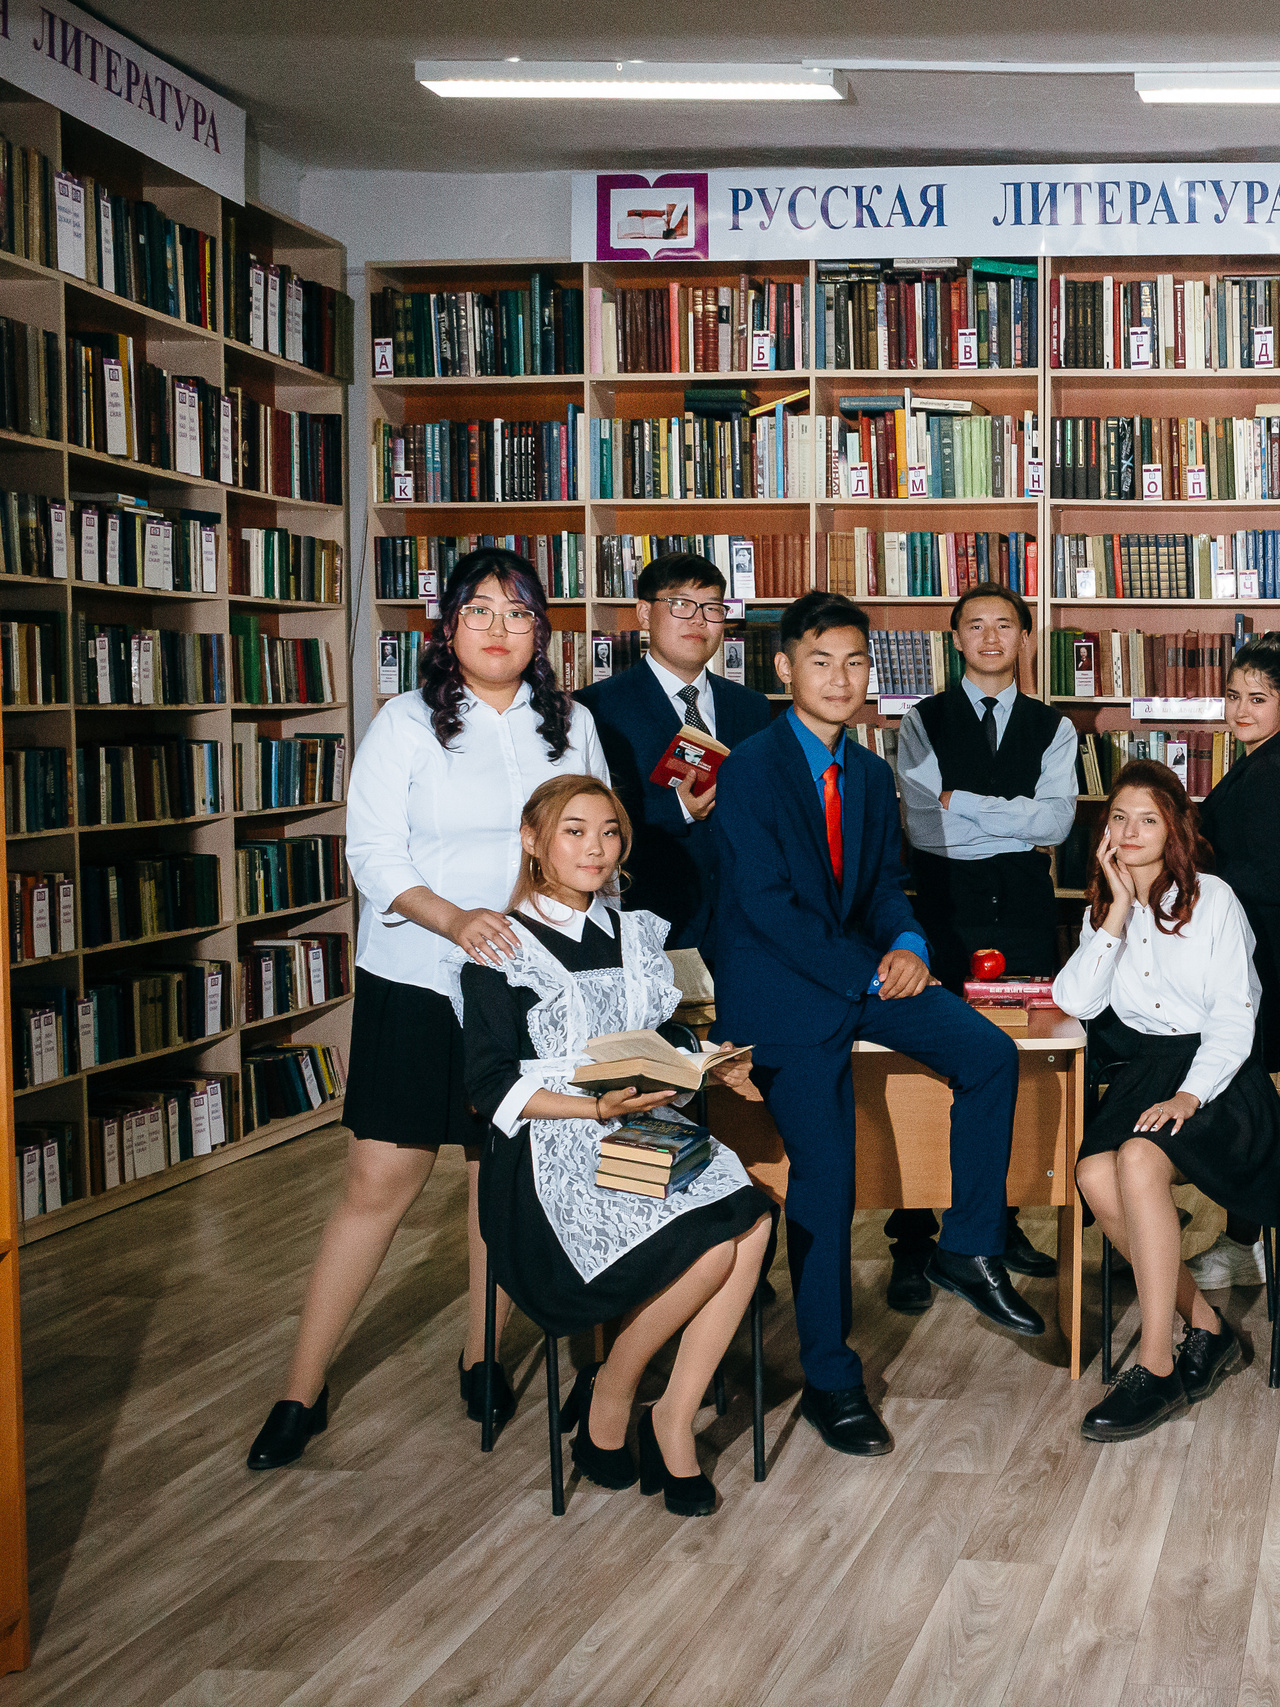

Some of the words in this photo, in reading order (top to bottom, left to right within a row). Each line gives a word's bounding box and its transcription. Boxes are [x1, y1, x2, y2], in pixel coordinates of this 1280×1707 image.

[33, 6, 221, 154] ЛИТЕРАТУРА
[727, 182, 949, 232] РУССКАЯ
[757, 345, 765, 361] Б
[963, 344, 973, 360] В
[1136, 343, 1144, 360] Г
[1258, 343, 1270, 361] Д
[379, 352, 390, 370] А
[832, 449, 840, 496] КУНИН
[854, 479, 865, 492] Л
[911, 478, 924, 492] М
[1031, 474, 1041, 489] Н
[1147, 480, 1158, 494] О
[1192, 481, 1202, 494] П
[399, 485, 409, 497] К
[423, 581, 432, 593] С
[1243, 581, 1253, 593] Ч
